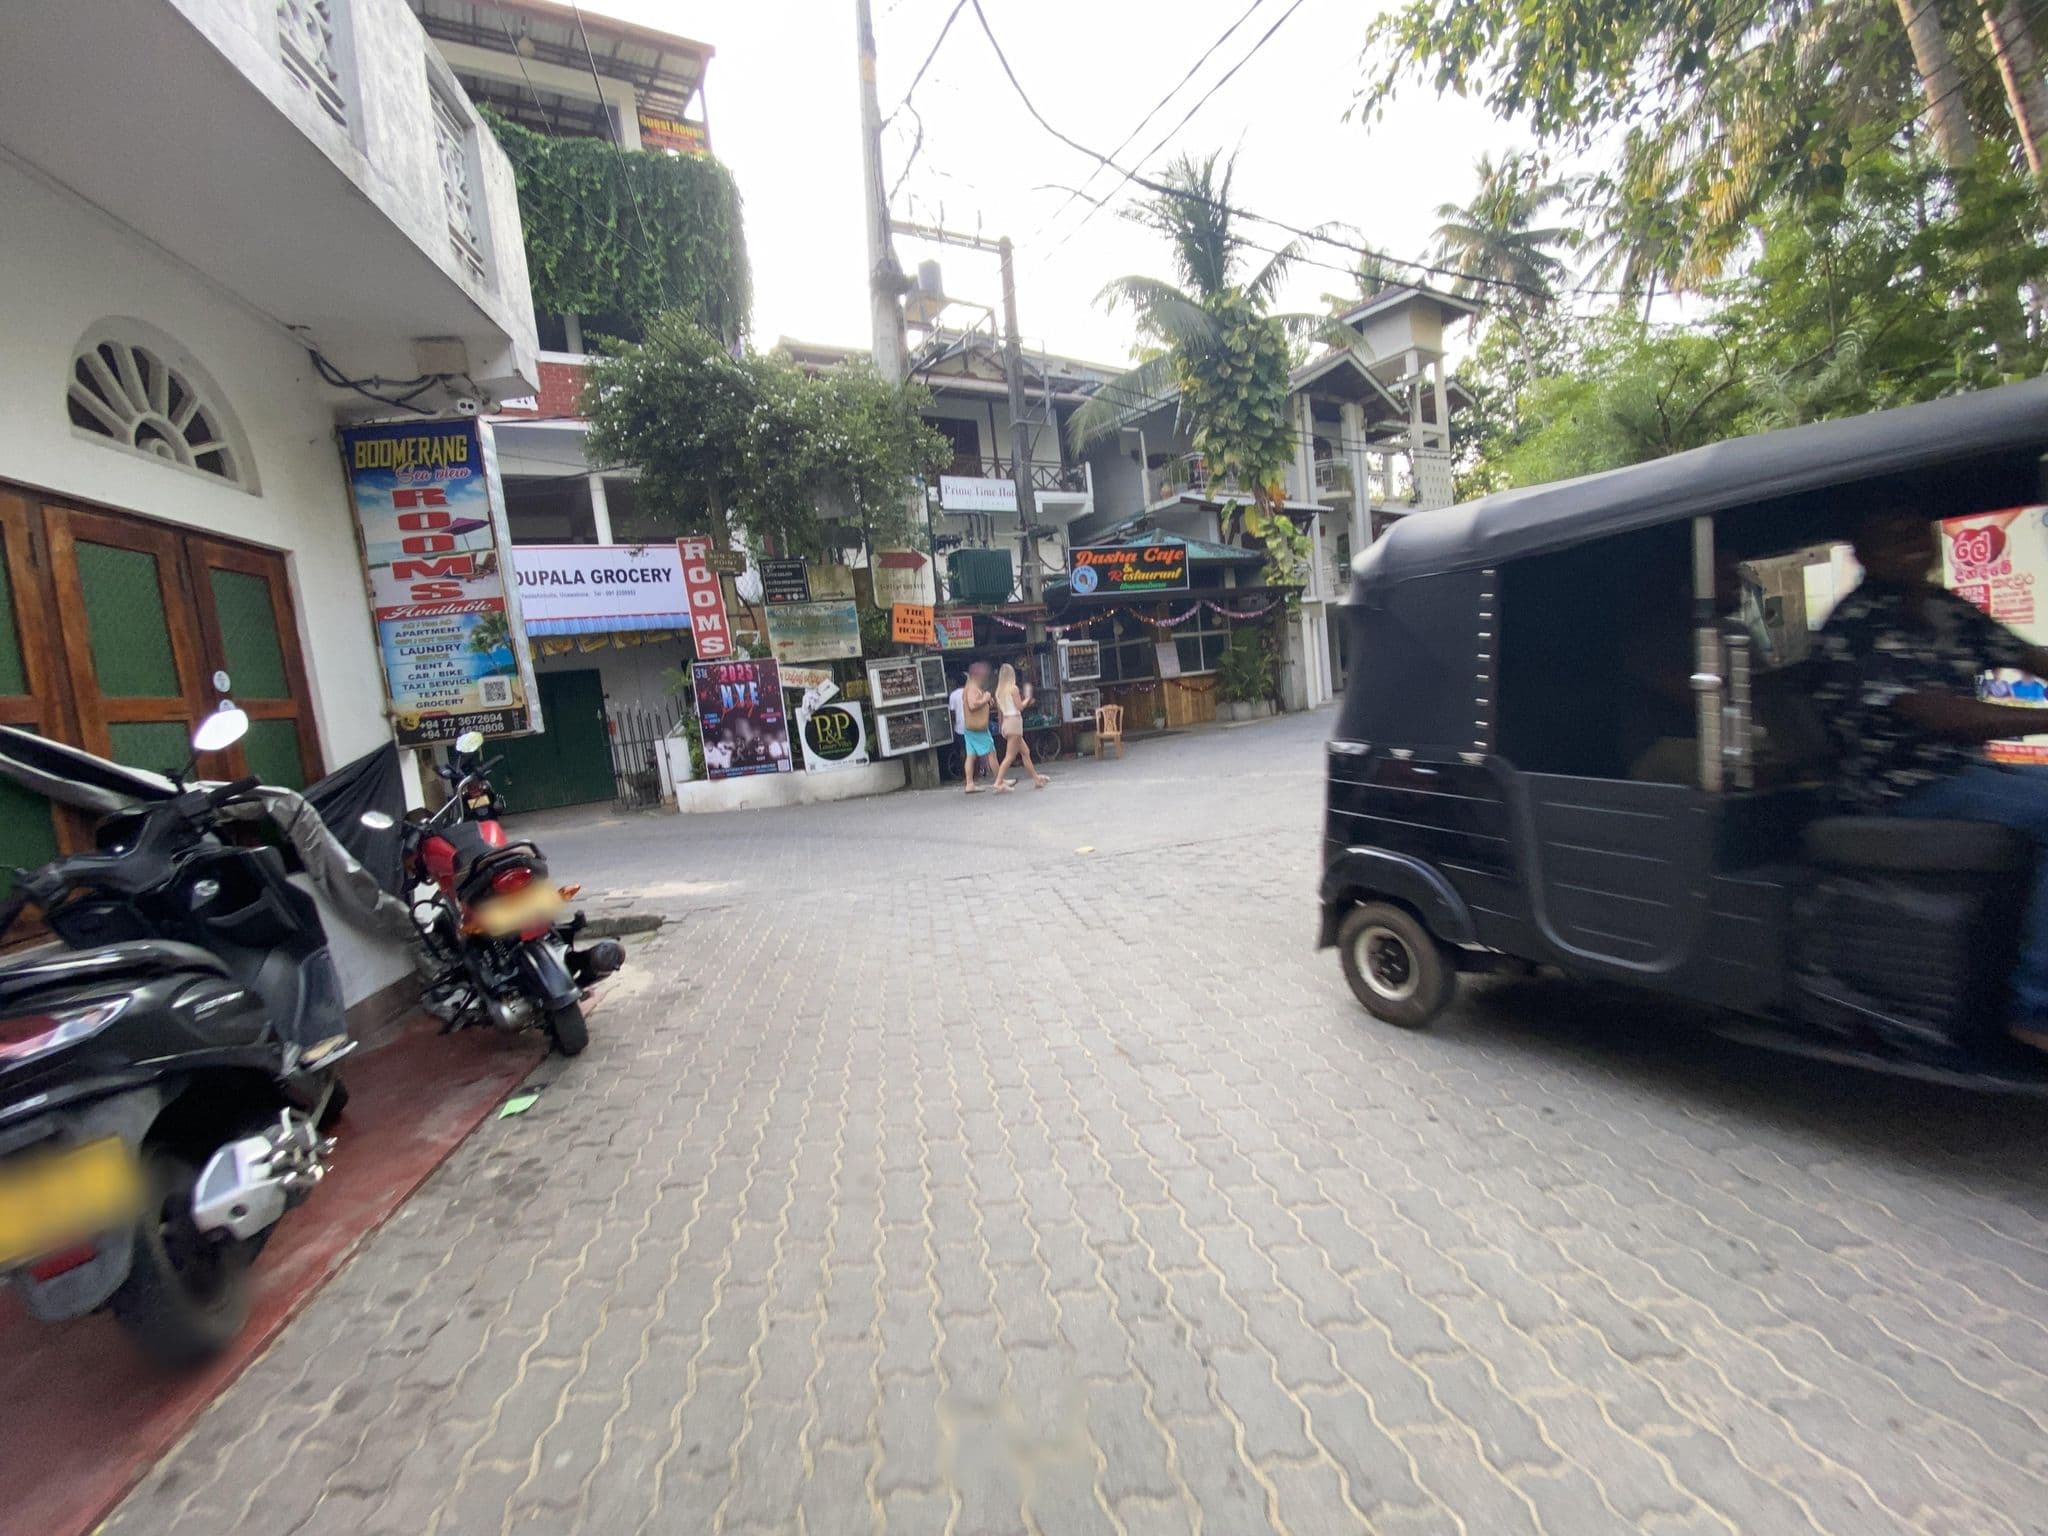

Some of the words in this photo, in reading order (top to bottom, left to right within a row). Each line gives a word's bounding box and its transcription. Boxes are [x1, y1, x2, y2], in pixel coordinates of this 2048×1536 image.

[354, 434, 468, 470] BOOMERANG
[395, 463, 431, 483] Sea
[944, 485, 972, 497] Prime
[999, 486, 1017, 498] Hot
[391, 487, 474, 601] ROOMS
[1143, 547, 1185, 565] Cafe
[590, 567, 672, 585] GROCERY
[1107, 567, 1183, 582] Restaurant
[682, 543, 725, 653] ROOMS
[384, 600, 492, 620] Available
[904, 608, 925, 616] THE
[896, 617, 932, 627] DREAM
[395, 626, 462, 638] APARTMENT
[899, 626, 930, 636] HOUSE
[400, 643, 461, 656] LAUNDRY
[415, 661, 442, 671] RENT
[446, 660, 454, 668] A
[407, 672, 431, 681] CAR
[438, 668, 463, 677] BIKE
[720, 663, 753, 683] 2025
[401, 682, 426, 691] TAXI
[428, 677, 473, 688] SERVICE
[418, 688, 460, 699] TEXTILE
[720, 681, 760, 710] NYE
[415, 697, 464, 709] GROCERY
[420, 718, 440, 730] +94
[441, 717, 456, 727] 77
[813, 713, 850, 746] P&P
[421, 729, 441, 740] +94
[443, 727, 457, 737] 77
